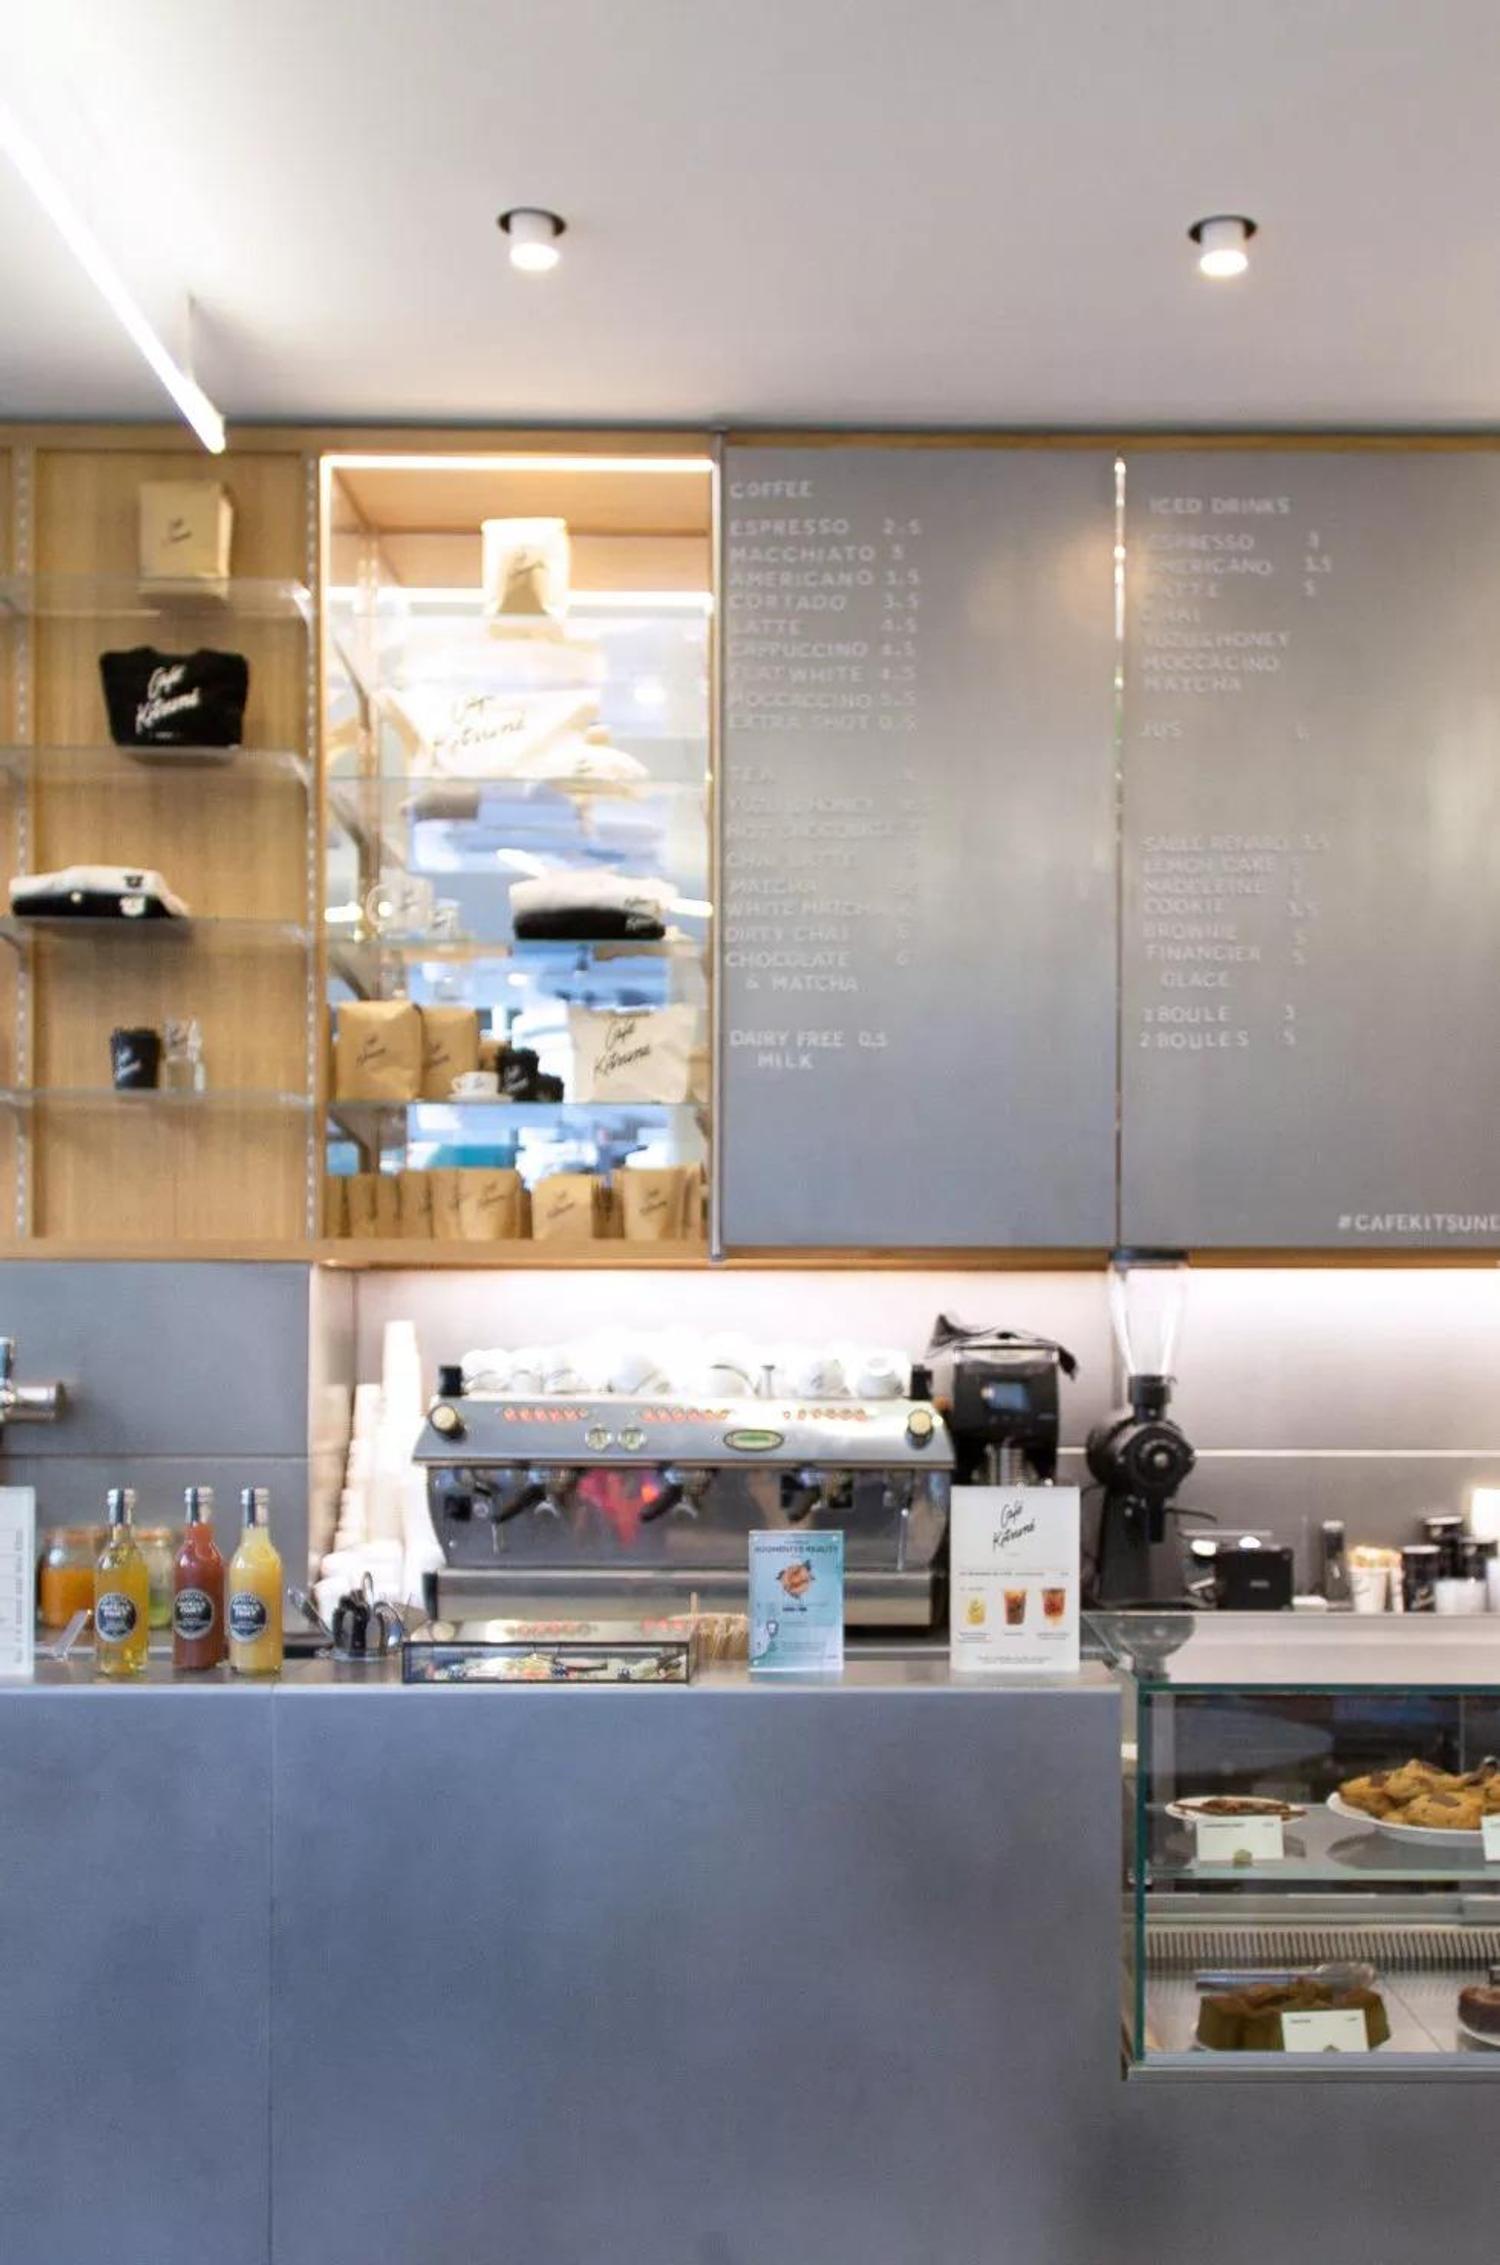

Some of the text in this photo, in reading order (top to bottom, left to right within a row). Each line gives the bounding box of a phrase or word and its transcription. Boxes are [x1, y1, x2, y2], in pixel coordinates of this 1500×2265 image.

[729, 480, 813, 498] COFFEE
[1150, 497, 1291, 514] ICED DRINKS
[729, 518, 849, 536] ESPRESSO
[729, 545, 877, 563] MACCHIATO
[729, 569, 874, 587] AMERICANO
[729, 594, 847, 611] CORTADO
[730, 618, 801, 636] LATTE
[729, 641, 868, 658] CAPPUCCINO
[788, 665, 864, 683] WHITE
[725, 951, 850, 968] CHOCOLATE
[1145, 943, 1261, 962] FINANCIER
[771, 974, 859, 992] MATCHA
[1157, 1005, 1232, 1023] BOULE
[730, 1030, 789, 1047] DAIRY
[797, 1030, 845, 1047] FREE
[1157, 1030, 1250, 1049] BOULES
[757, 1053, 814, 1071] MILK
